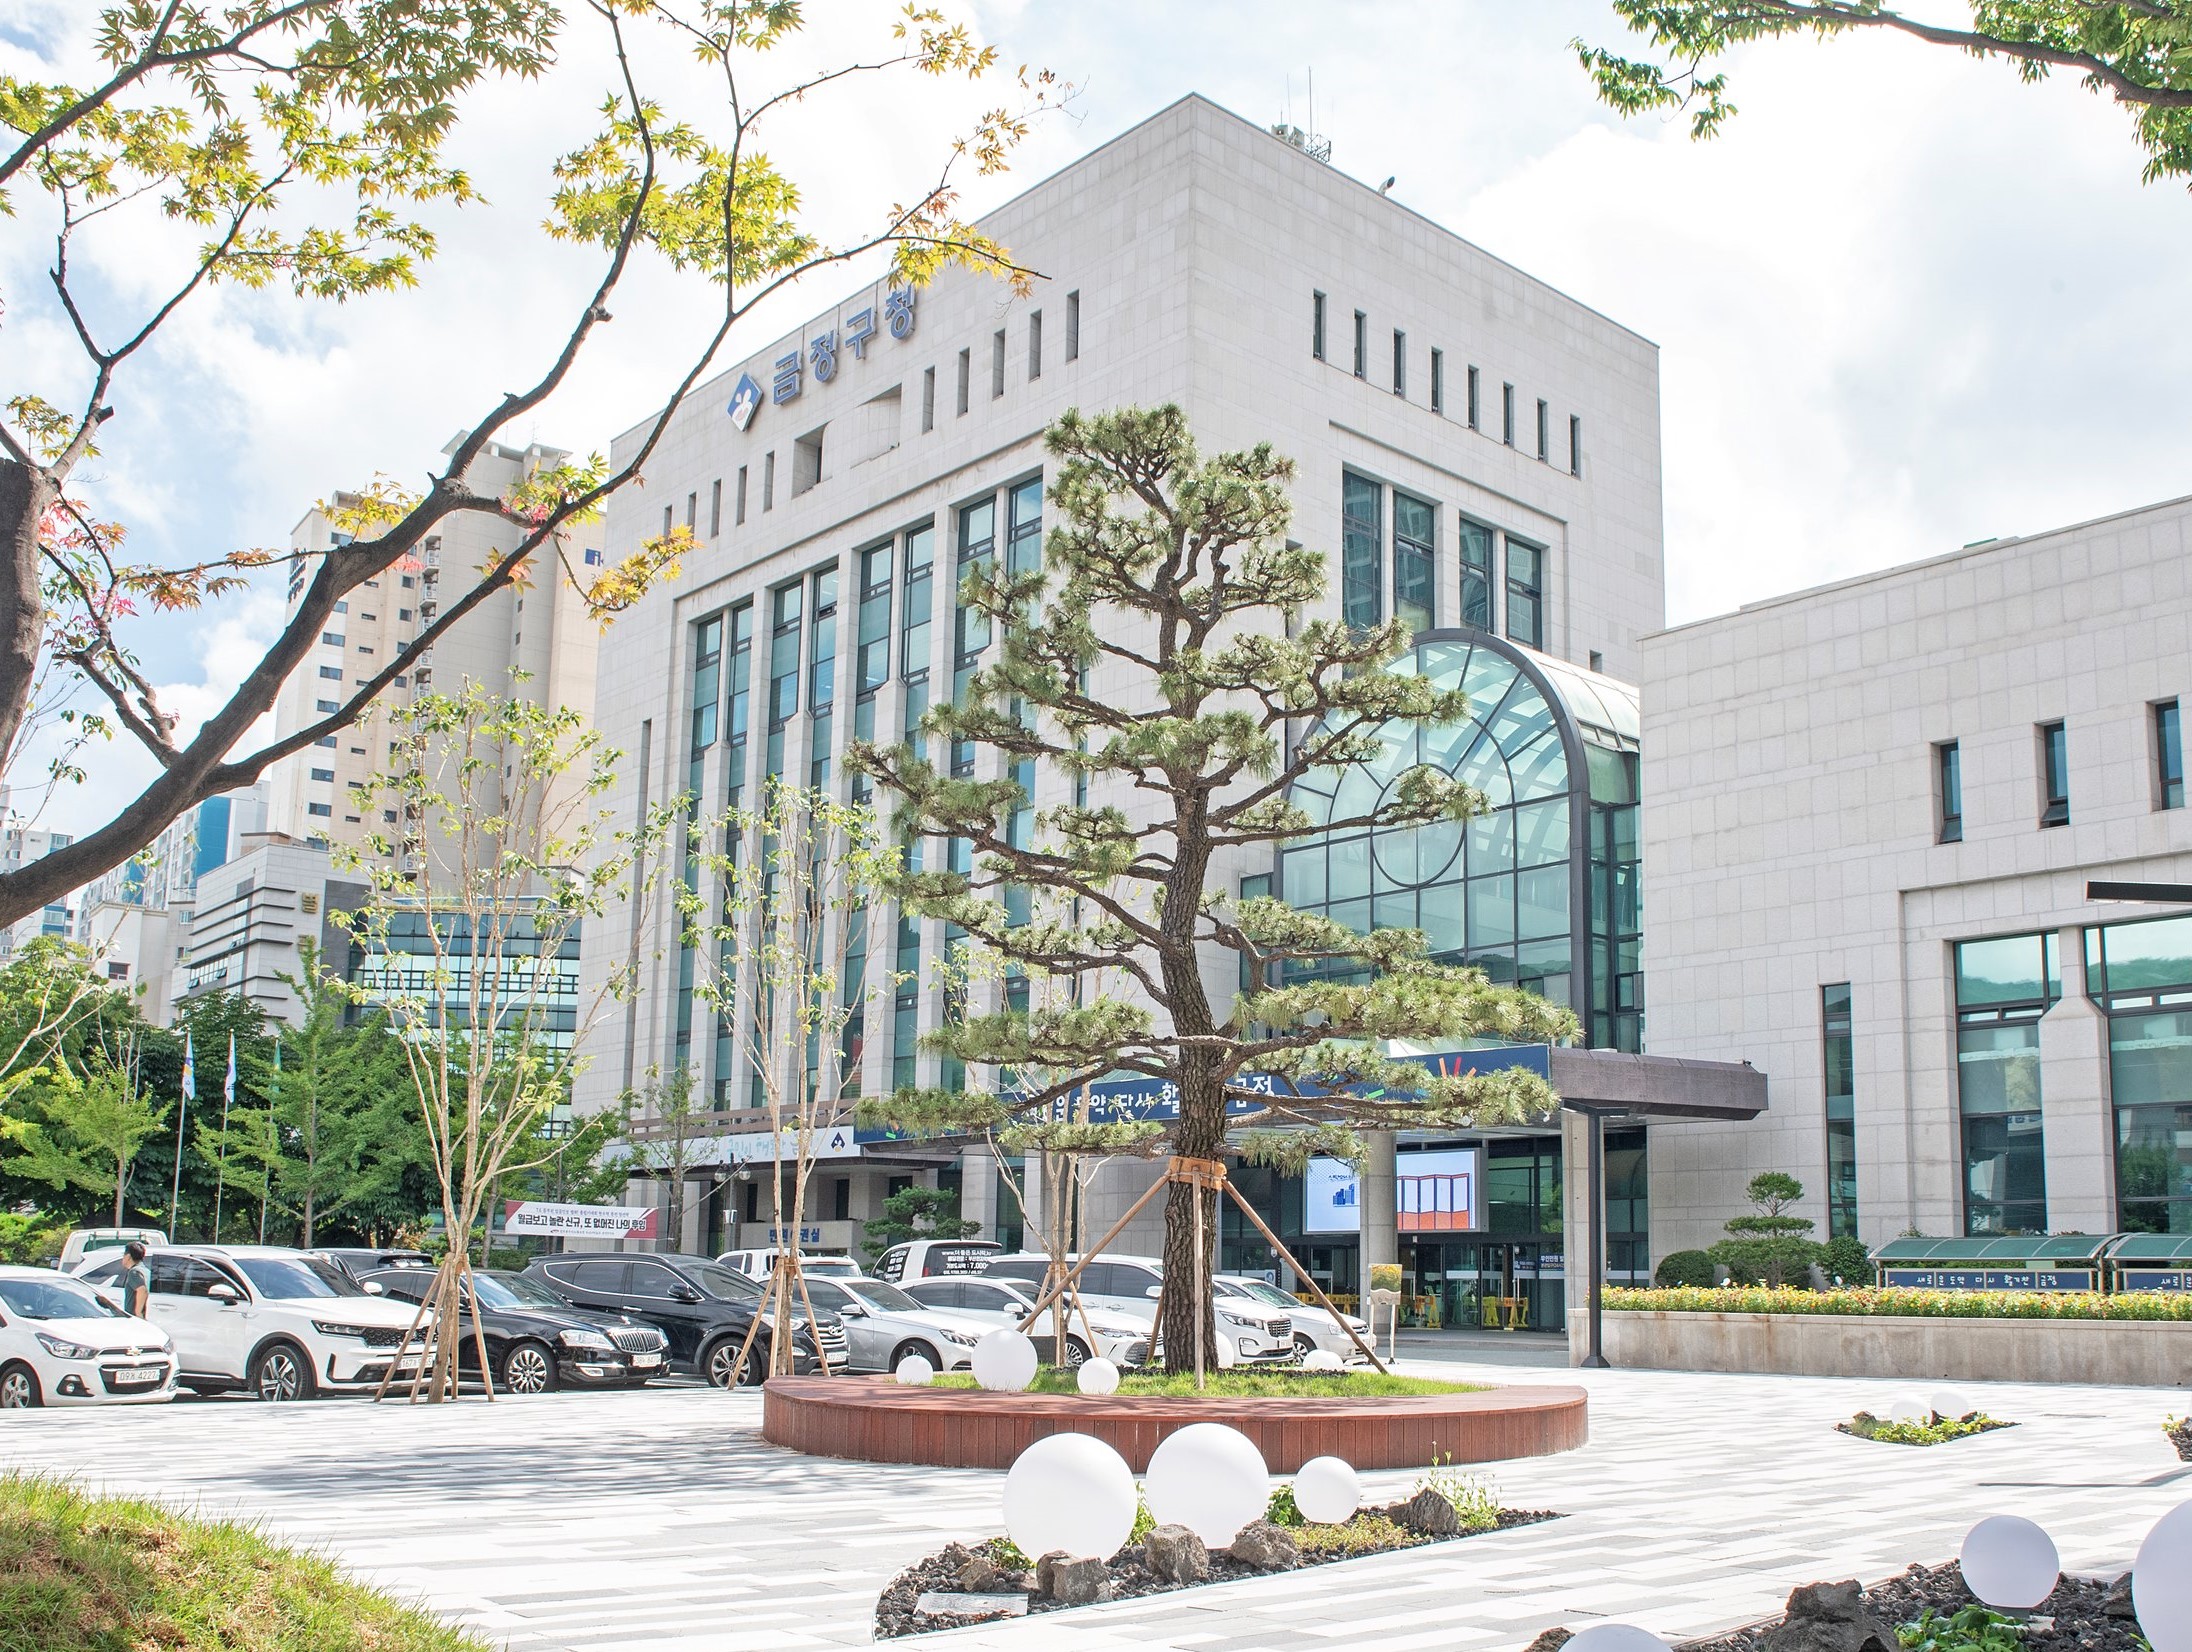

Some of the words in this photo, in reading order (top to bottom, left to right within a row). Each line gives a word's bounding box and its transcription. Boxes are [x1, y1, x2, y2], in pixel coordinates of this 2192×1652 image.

[773, 283, 916, 405] 금정구청
[518, 1213, 548, 1226] 월급보고
[549, 1215, 564, 1227] 놀란
[584, 1217, 592, 1229] 또
[616, 1218, 631, 1230] 나의
[769, 1227, 820, 1243] 민원권실
[1916, 1274, 1944, 1287] 새로운
[1950, 1275, 1965, 1286] 도약
[2003, 1274, 2030, 1287] 활기찬
[2040, 1274, 2057, 1287] 금정
